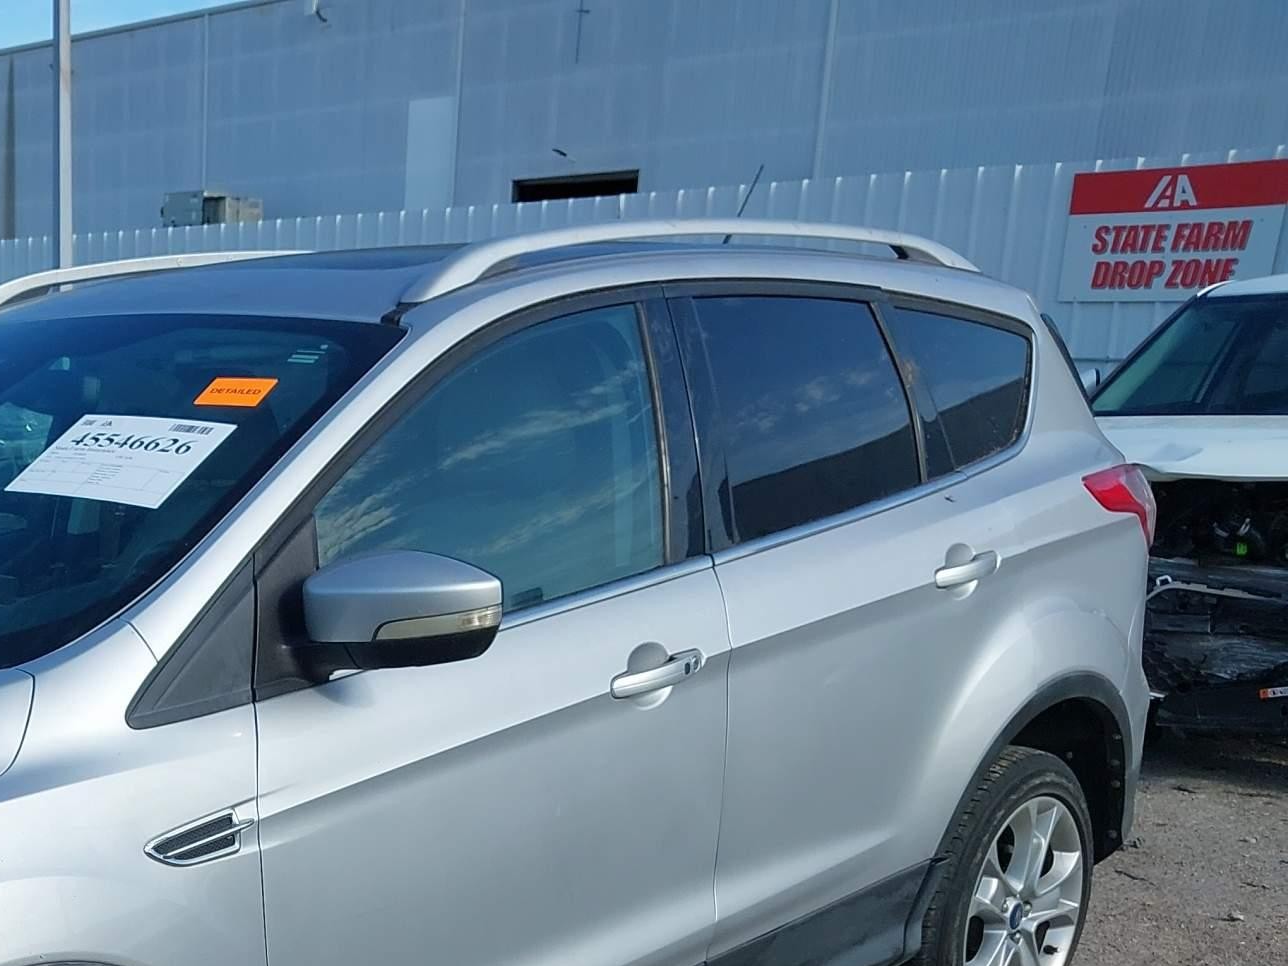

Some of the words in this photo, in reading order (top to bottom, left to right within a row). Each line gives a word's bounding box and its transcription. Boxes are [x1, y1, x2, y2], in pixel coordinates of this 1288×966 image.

[1091, 223, 1171, 256] STATE
[1171, 219, 1253, 252] FARM
[1091, 260, 1166, 290] DROP
[1164, 258, 1240, 290] ZONE
[209, 387, 262, 396] DETAILED
[70, 431, 199, 456] 45546626
